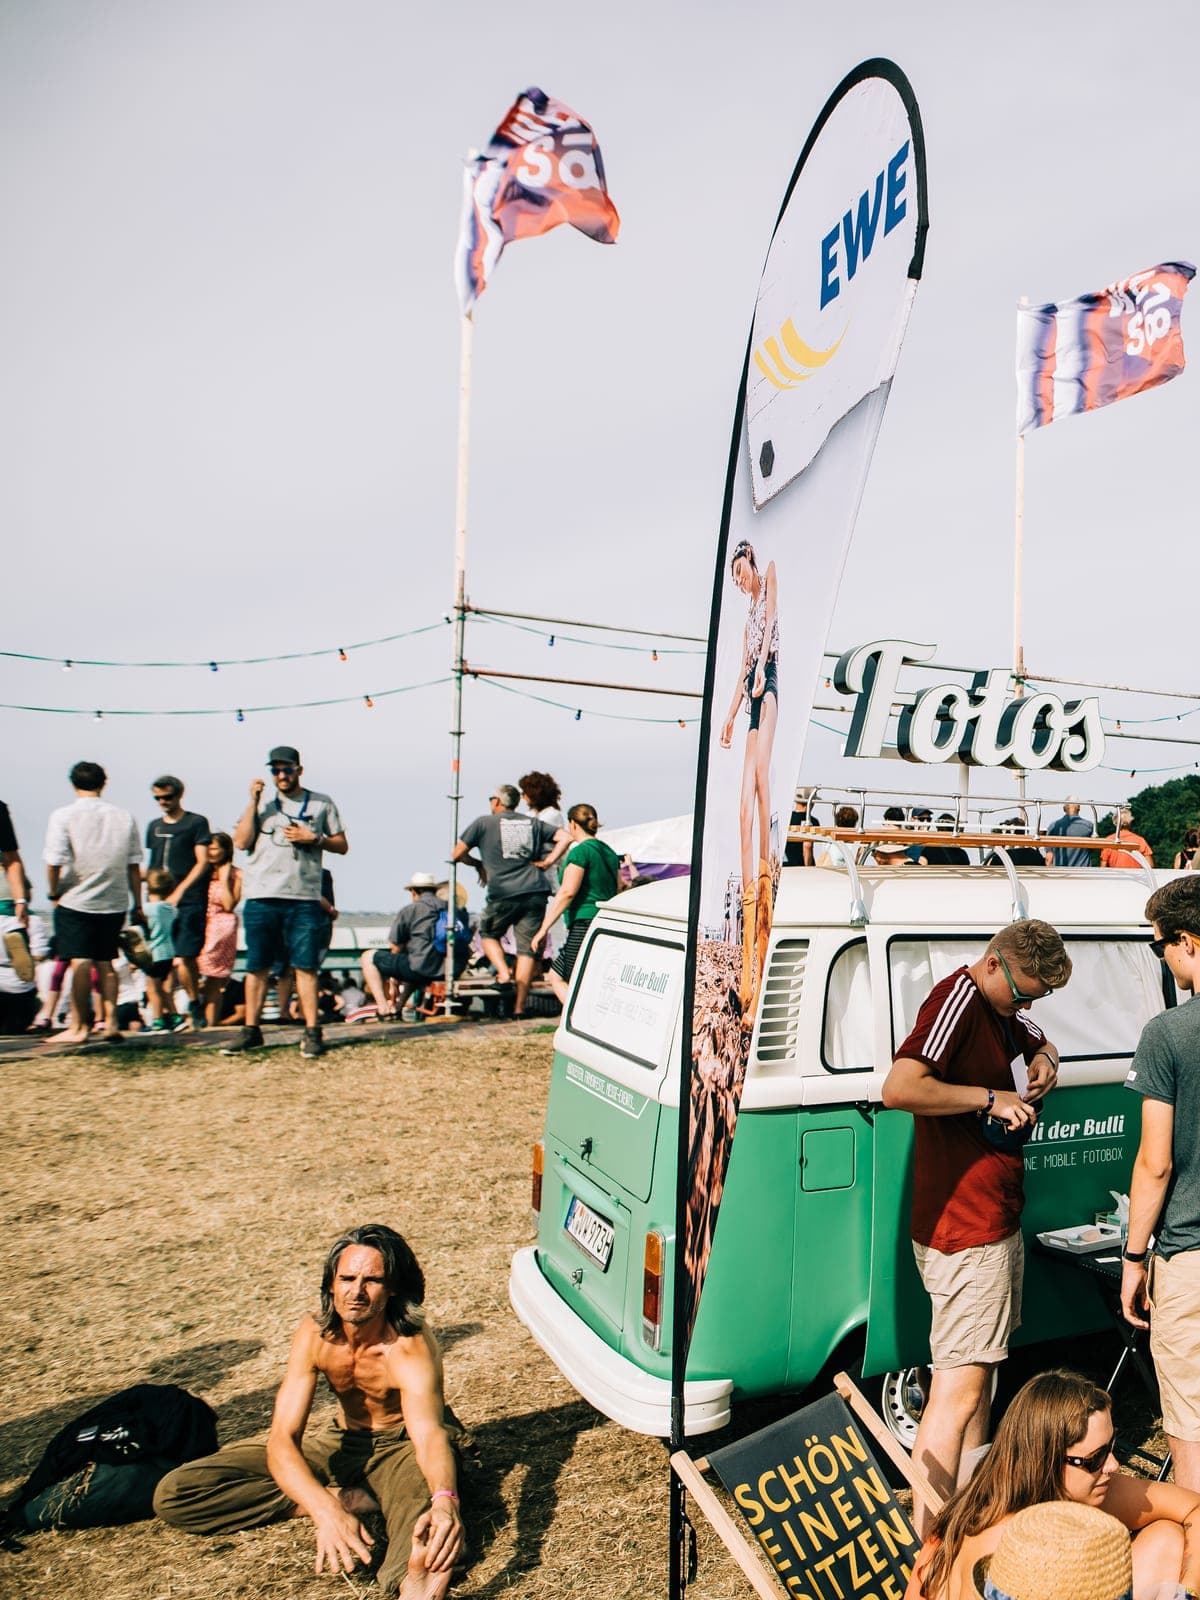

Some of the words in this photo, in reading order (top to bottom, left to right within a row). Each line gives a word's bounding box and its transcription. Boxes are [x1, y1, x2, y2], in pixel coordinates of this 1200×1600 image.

[820, 139, 910, 311] EWE
[834, 639, 1105, 772] Fotos
[620, 963, 637, 984] Ulli
[633, 967, 649, 988] der
[646, 971, 670, 994] Bulli
[1023, 1156, 1038, 1171] INE
[1044, 1152, 1077, 1168] MOBILE
[1083, 1147, 1123, 1164] FOTOBOX
[1048, 1120, 1080, 1140] der
[1083, 1114, 1125, 1136] Bulli
[733, 1425, 868, 1526] SCHÖN
[758, 1466, 891, 1572] EINEN
[786, 1507, 914, 1600] SITZEN
